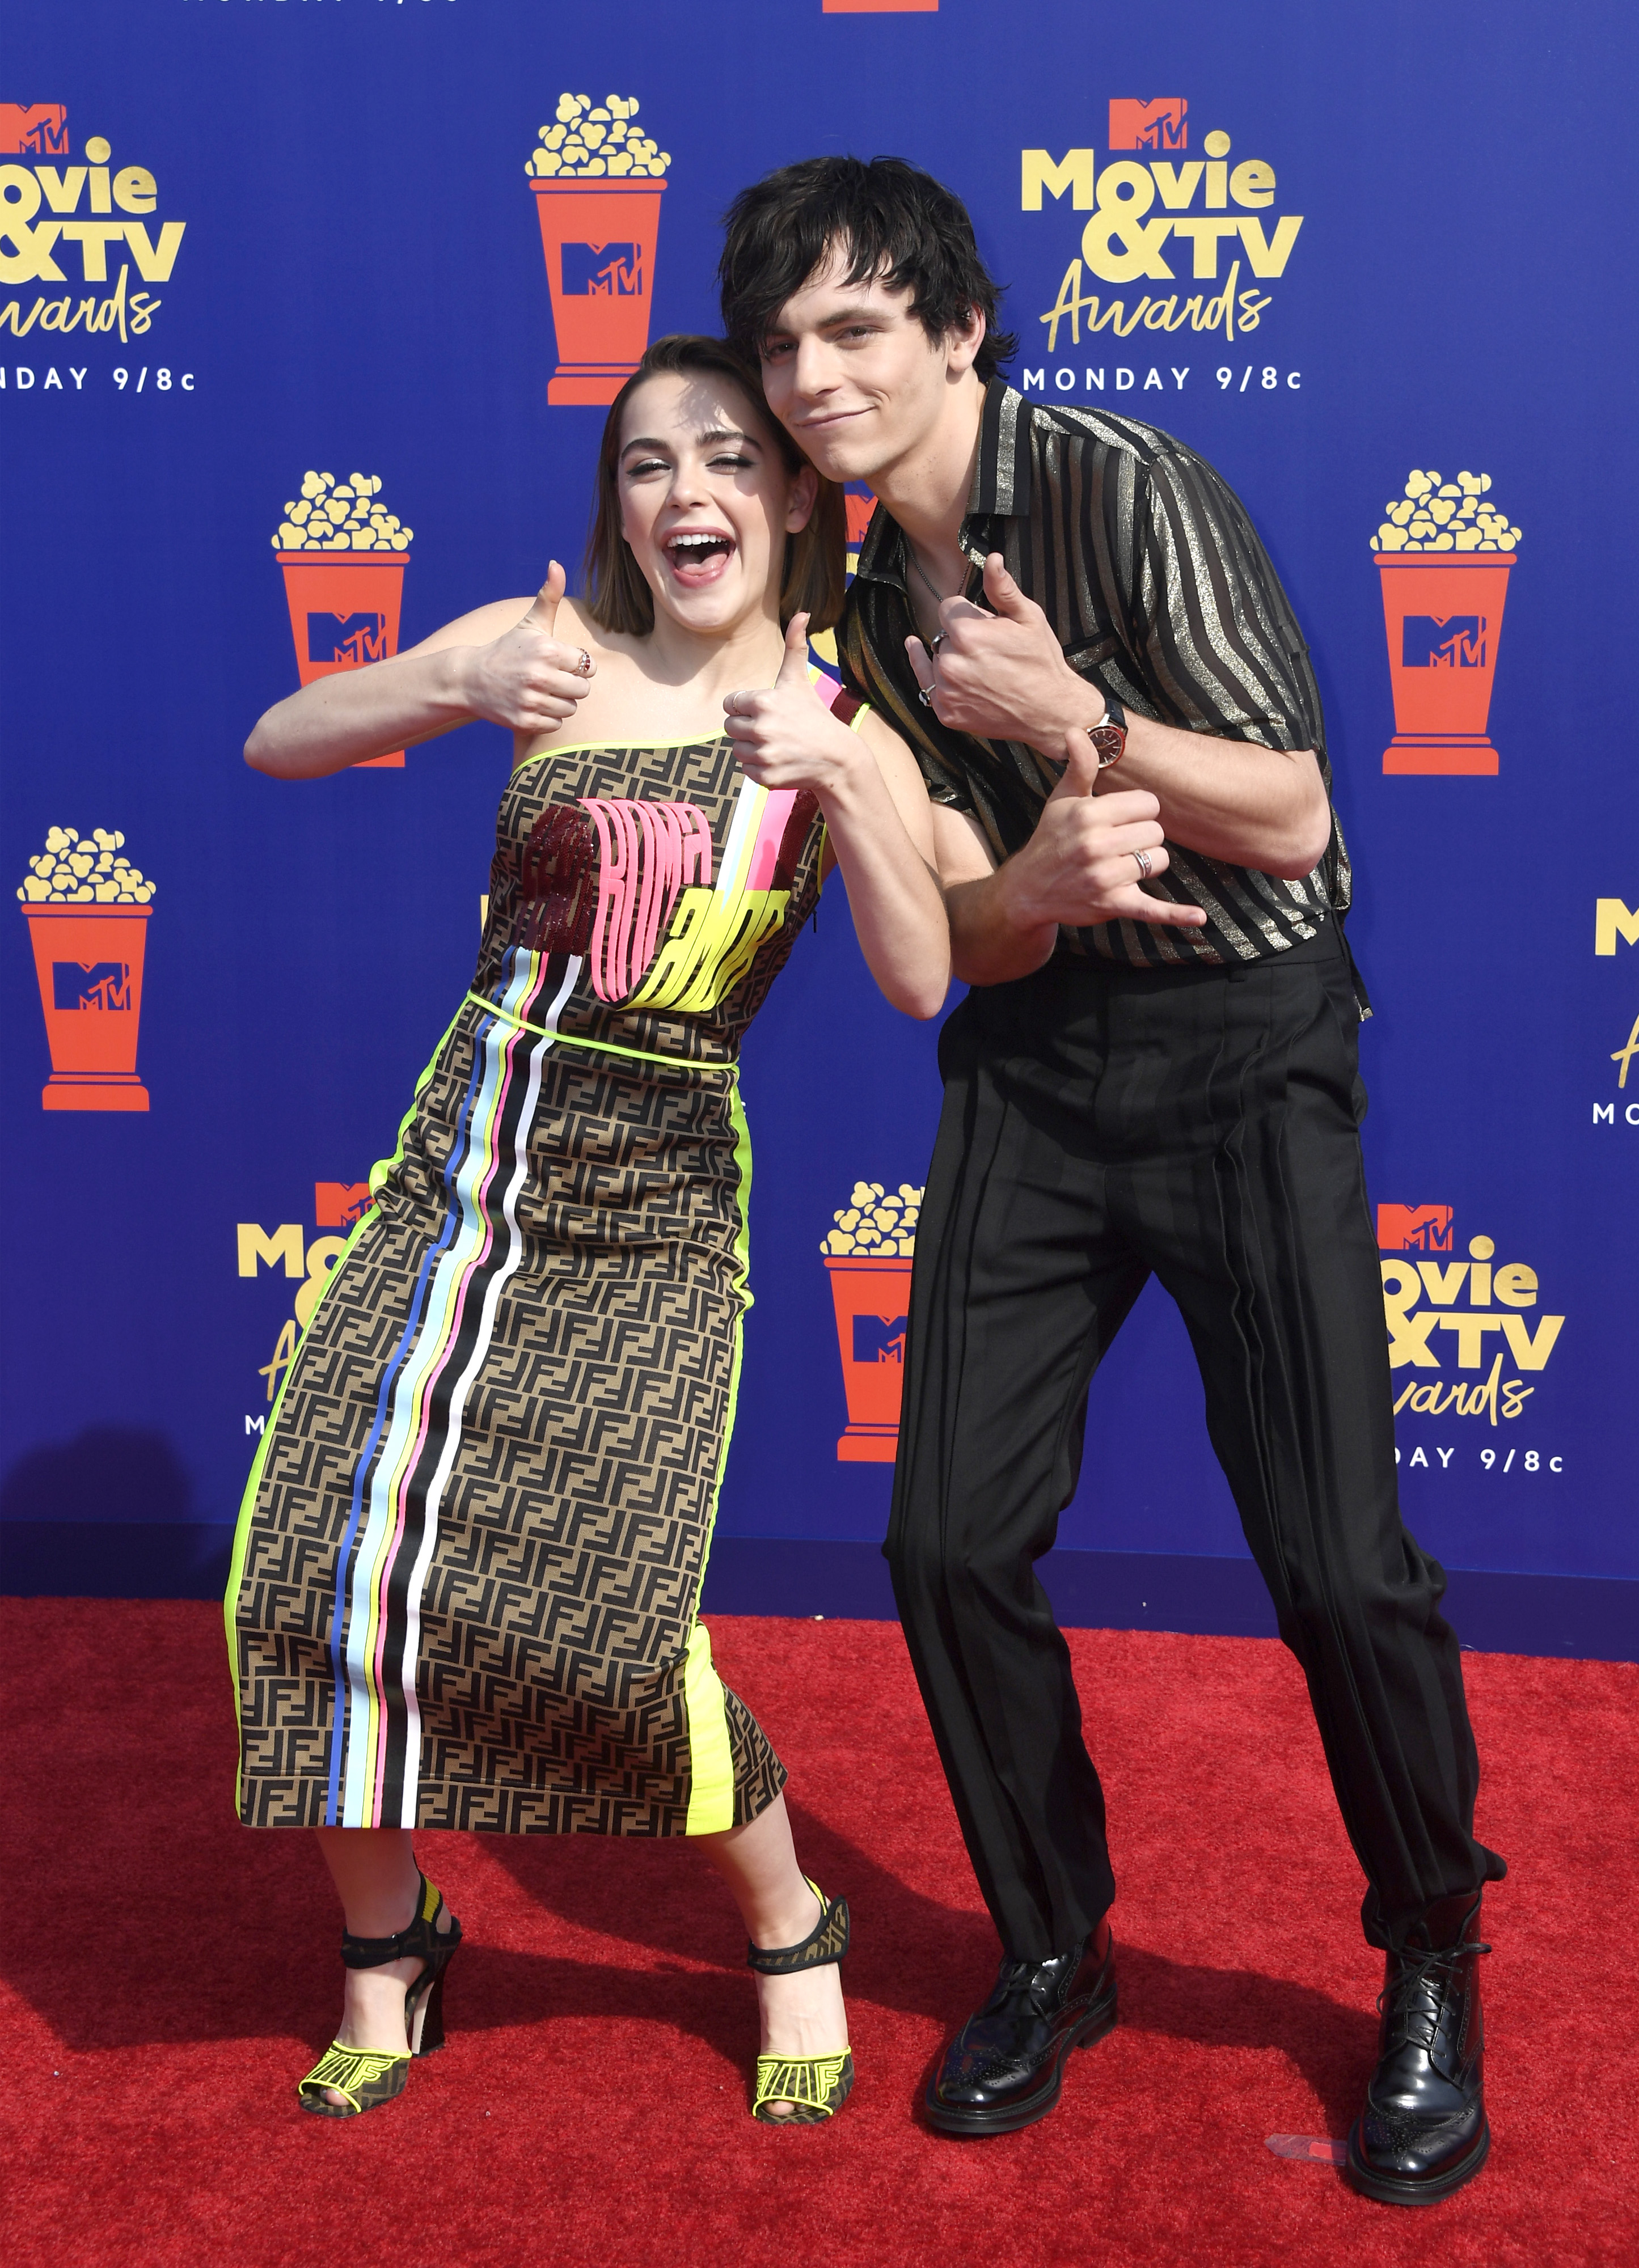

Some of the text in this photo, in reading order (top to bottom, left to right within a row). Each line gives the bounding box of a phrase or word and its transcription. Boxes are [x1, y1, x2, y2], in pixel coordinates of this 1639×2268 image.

[0, 103, 69, 154] MTV
[1109, 98, 1188, 150] MTV
[0, 136, 157, 218] ovie
[1021, 130, 1276, 211] Movie
[561, 242, 641, 295] MTV
[1082, 215, 1304, 283] &TV
[0, 264, 162, 343] wards
[1039, 259, 1272, 353] Awards
[113, 367, 195, 393] 9/8c
[1023, 366, 1300, 392] MONDAY 9/8c
[307, 612, 387, 663] MTV
[1402, 615, 1487, 667] MTV
[52, 962, 131, 1012] MTV
[1377, 1203, 1453, 1251] MTV
[1380, 1235, 1538, 1311] ovie
[1393, 1352, 1535, 1427] ards
[1480, 1449, 1563, 1473] 9/8c
